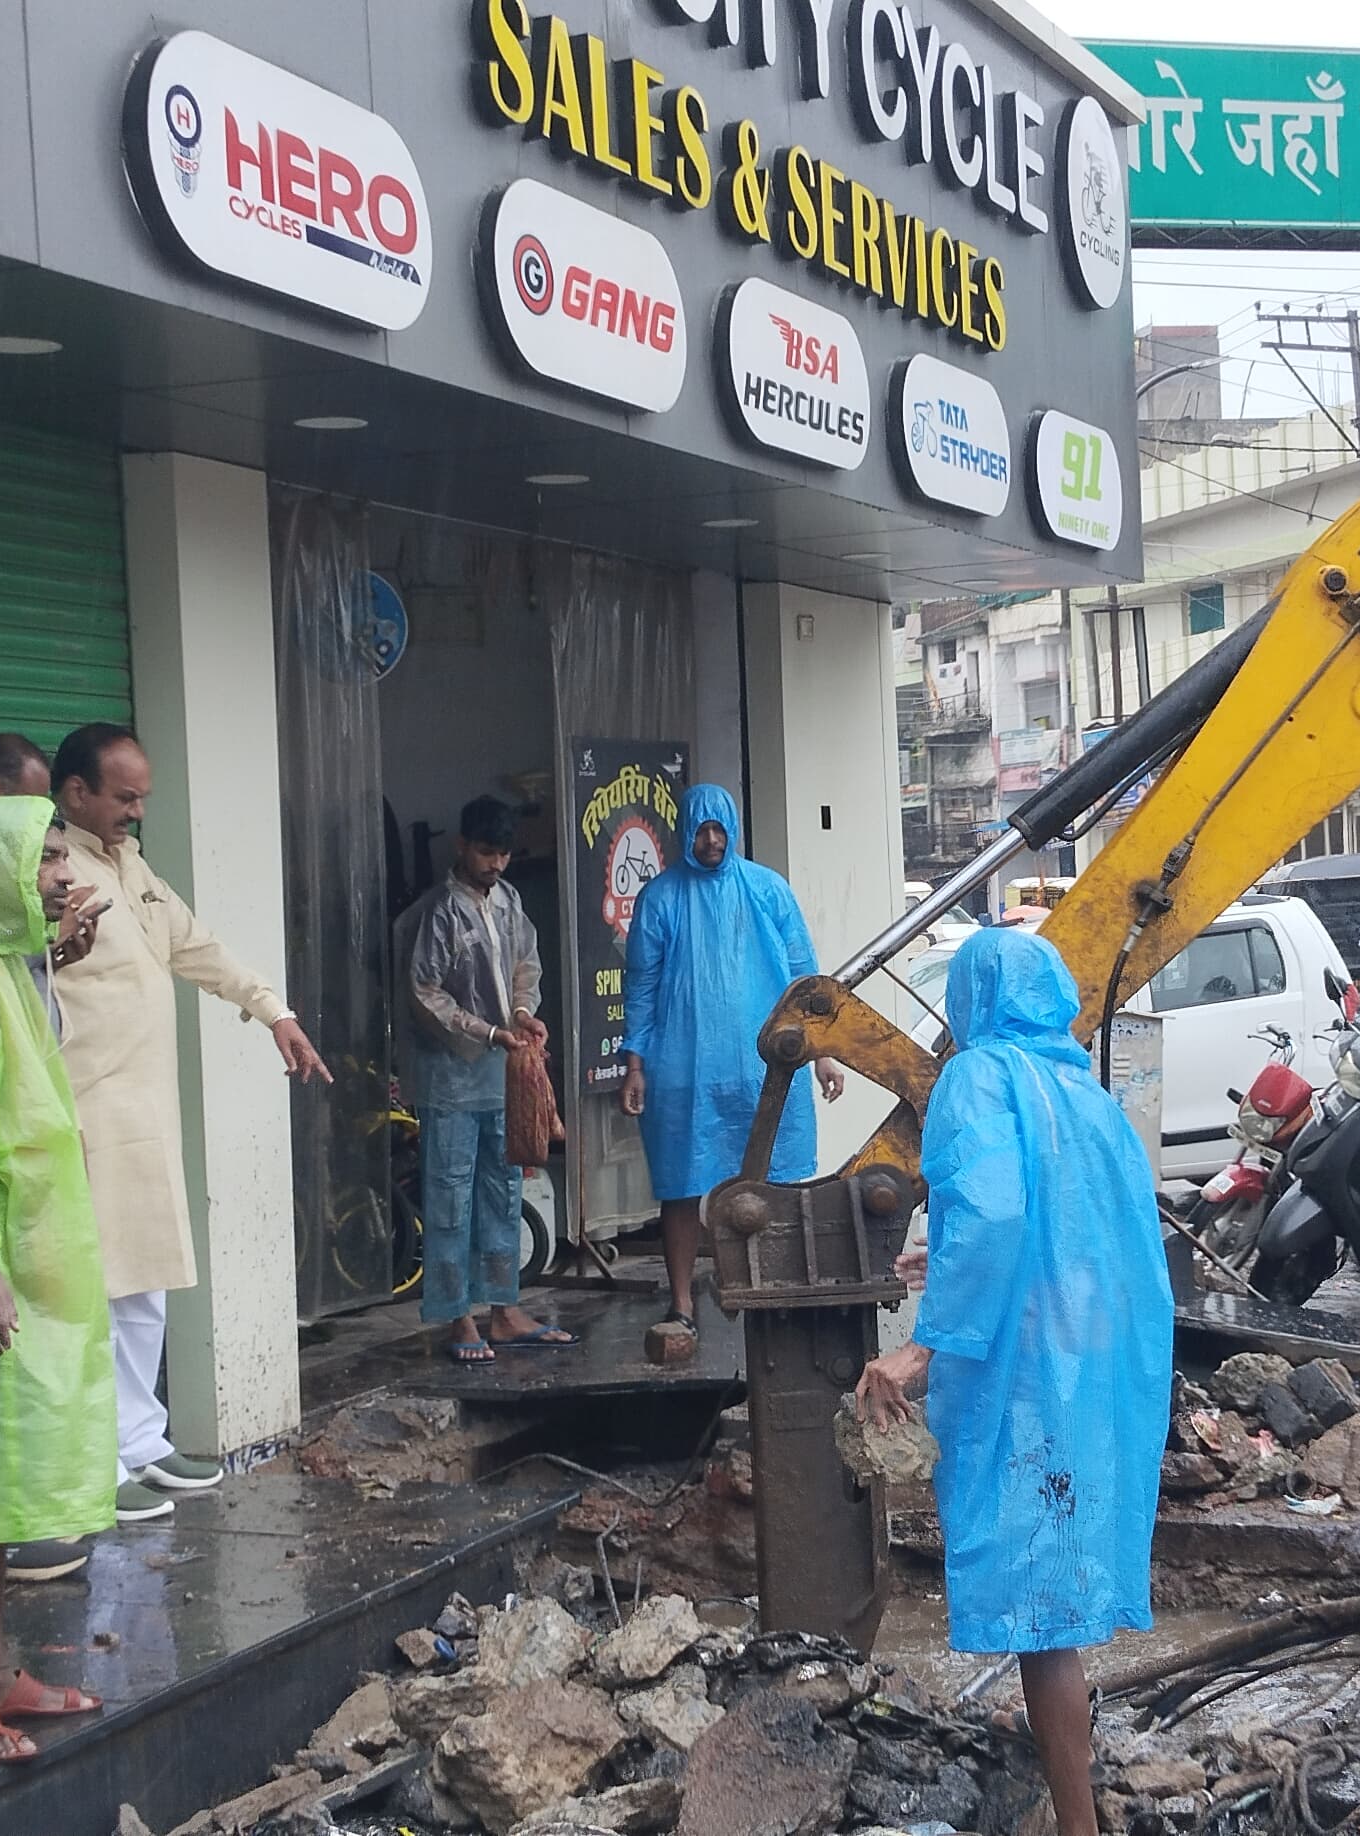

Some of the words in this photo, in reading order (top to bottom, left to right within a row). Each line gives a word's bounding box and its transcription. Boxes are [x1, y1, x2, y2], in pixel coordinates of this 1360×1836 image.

[861, 0, 1049, 234] CYCLE
[1128, 60, 1203, 176] ारे
[1221, 70, 1346, 196] जहाँ
[224, 104, 418, 255] HERO
[488, 0, 712, 209] SALES
[733, 118, 771, 244] &
[787, 144, 1007, 353] SERVICES
[228, 195, 303, 240] CYCLES
[524, 256, 544, 294] G
[1080, 231, 1121, 267] CYCLING
[561, 265, 676, 353] GANG
[782, 324, 839, 385] BSA
[744, 372, 865, 446] HERCULES
[938, 398, 969, 433] TATA
[940, 434, 1008, 484] STRYDER
[1061, 431, 1103, 502] 91
[1058, 511, 1090, 537] NINETY
[1091, 522, 1110, 542] ONE
[596, 968, 622, 996] SPIN
